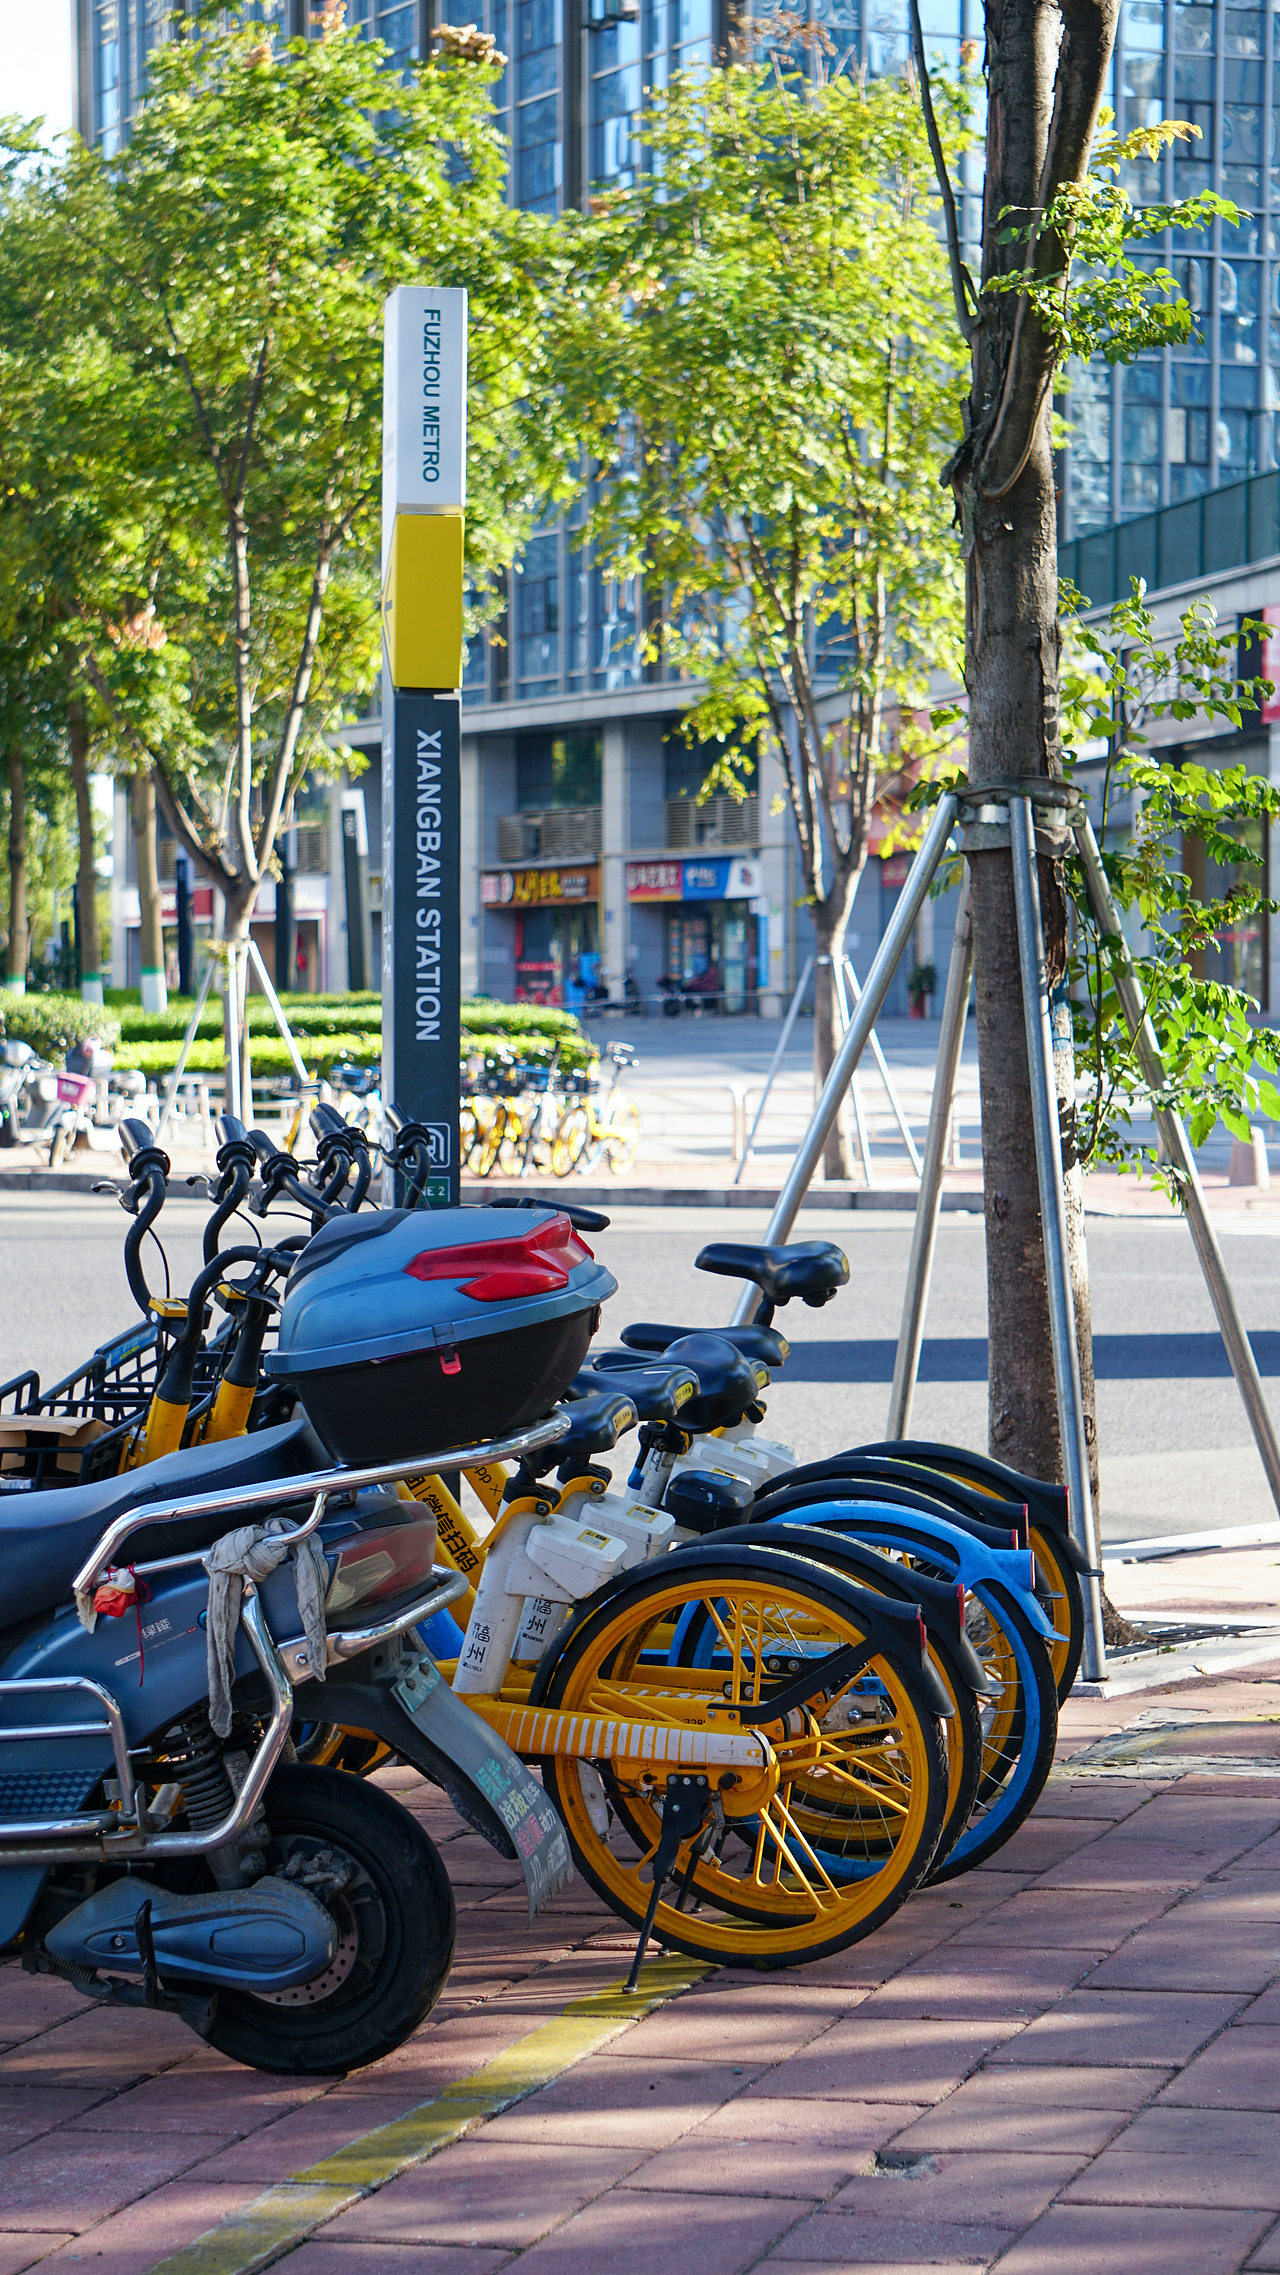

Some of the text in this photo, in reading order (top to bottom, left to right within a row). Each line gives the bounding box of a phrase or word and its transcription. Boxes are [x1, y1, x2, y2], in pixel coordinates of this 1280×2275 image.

[422, 309, 441, 483] FUZHOU METRO
[415, 729, 442, 1041] XIANGBAN STATION
[438, 1186, 445, 1196] 2
[474, 1466, 492, 1484] pp
[422, 1494, 480, 1573] 微信扫码
[467, 1621, 491, 1664] 福州
